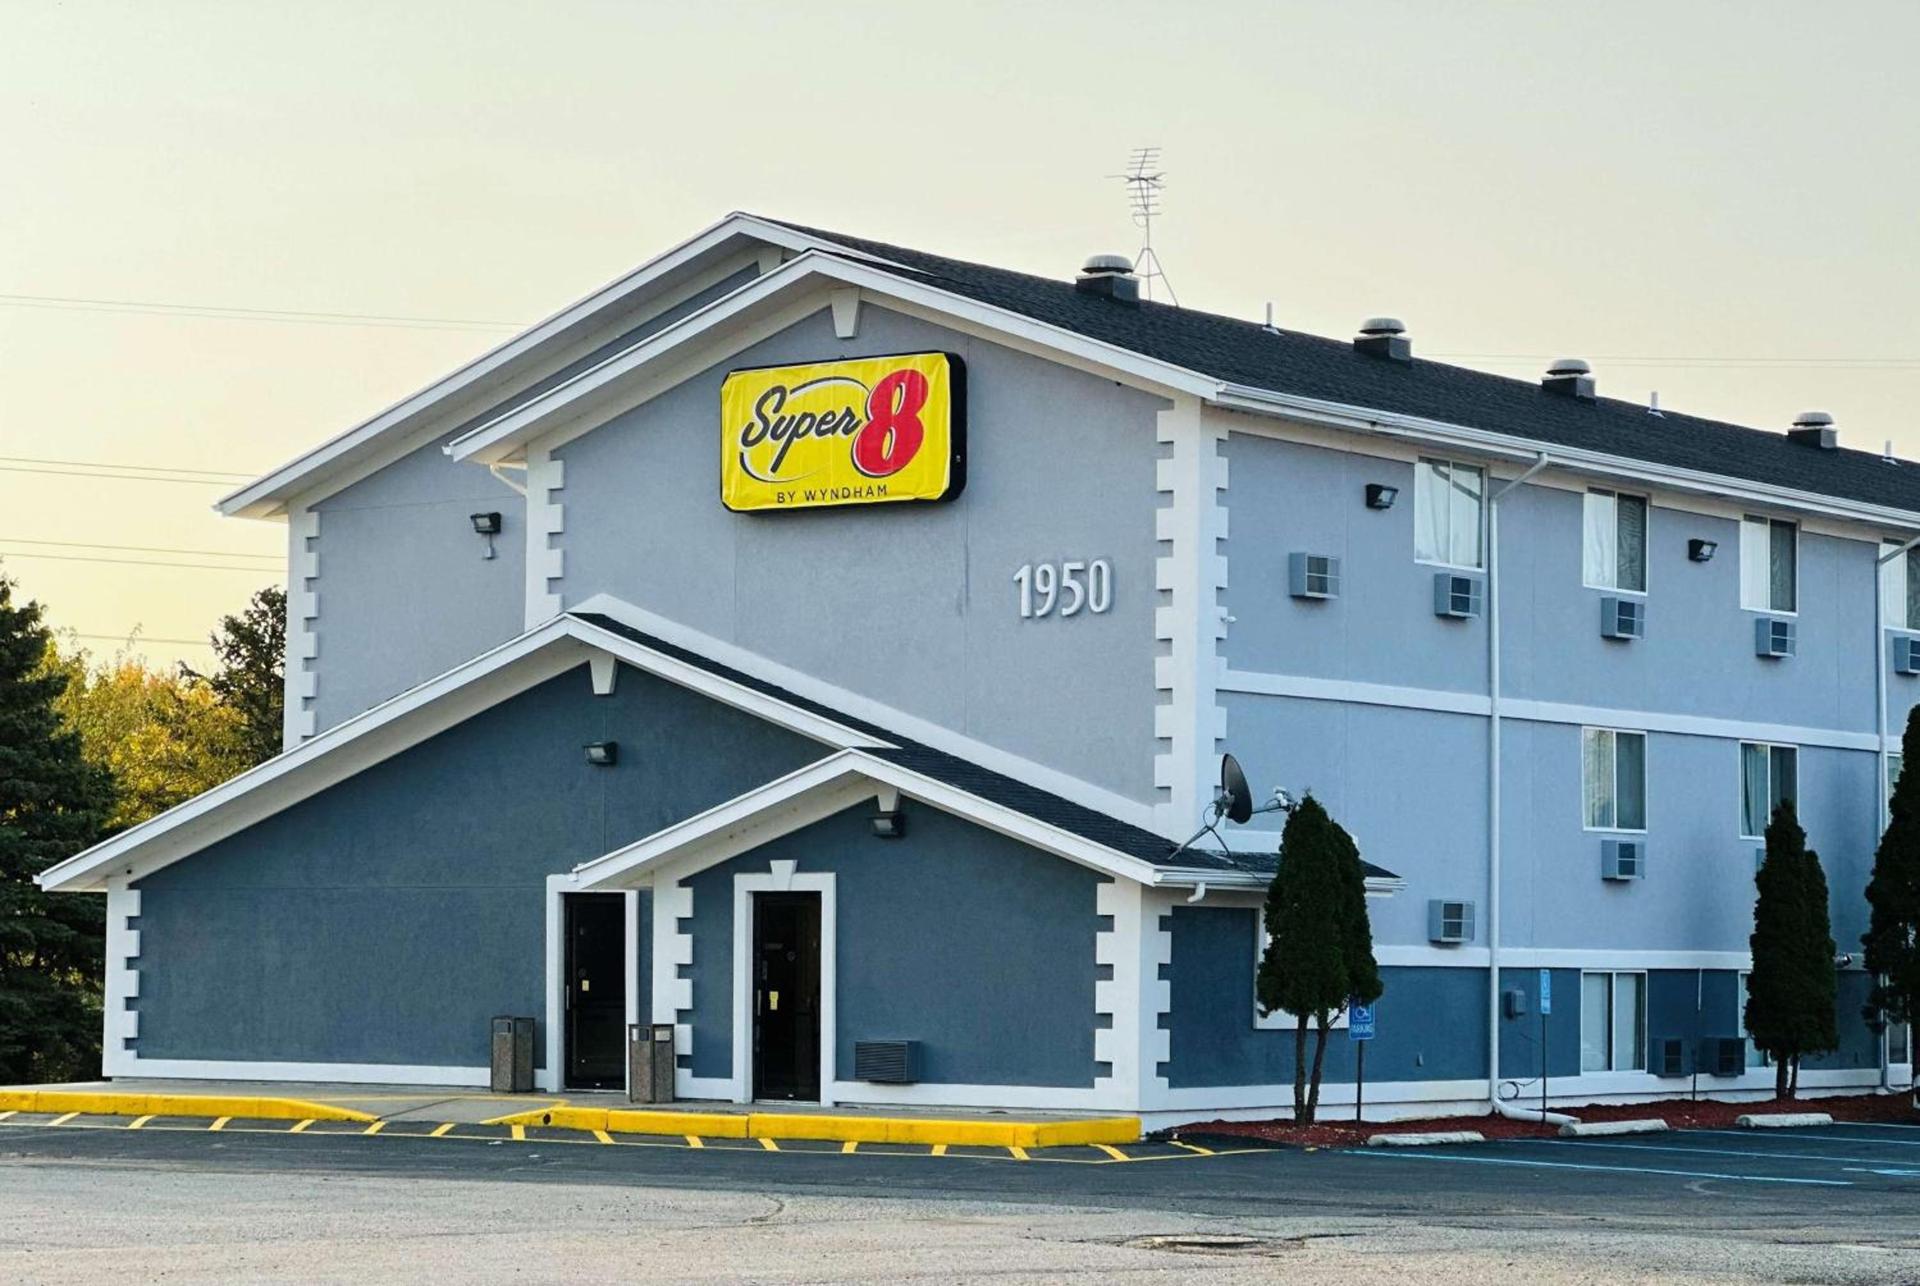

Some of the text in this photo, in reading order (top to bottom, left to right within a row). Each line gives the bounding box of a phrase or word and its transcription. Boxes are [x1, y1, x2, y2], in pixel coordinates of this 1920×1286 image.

[740, 369, 929, 478] Super 8
[776, 484, 888, 504] BY WYNDHAM
[1013, 560, 1111, 617] 1950
